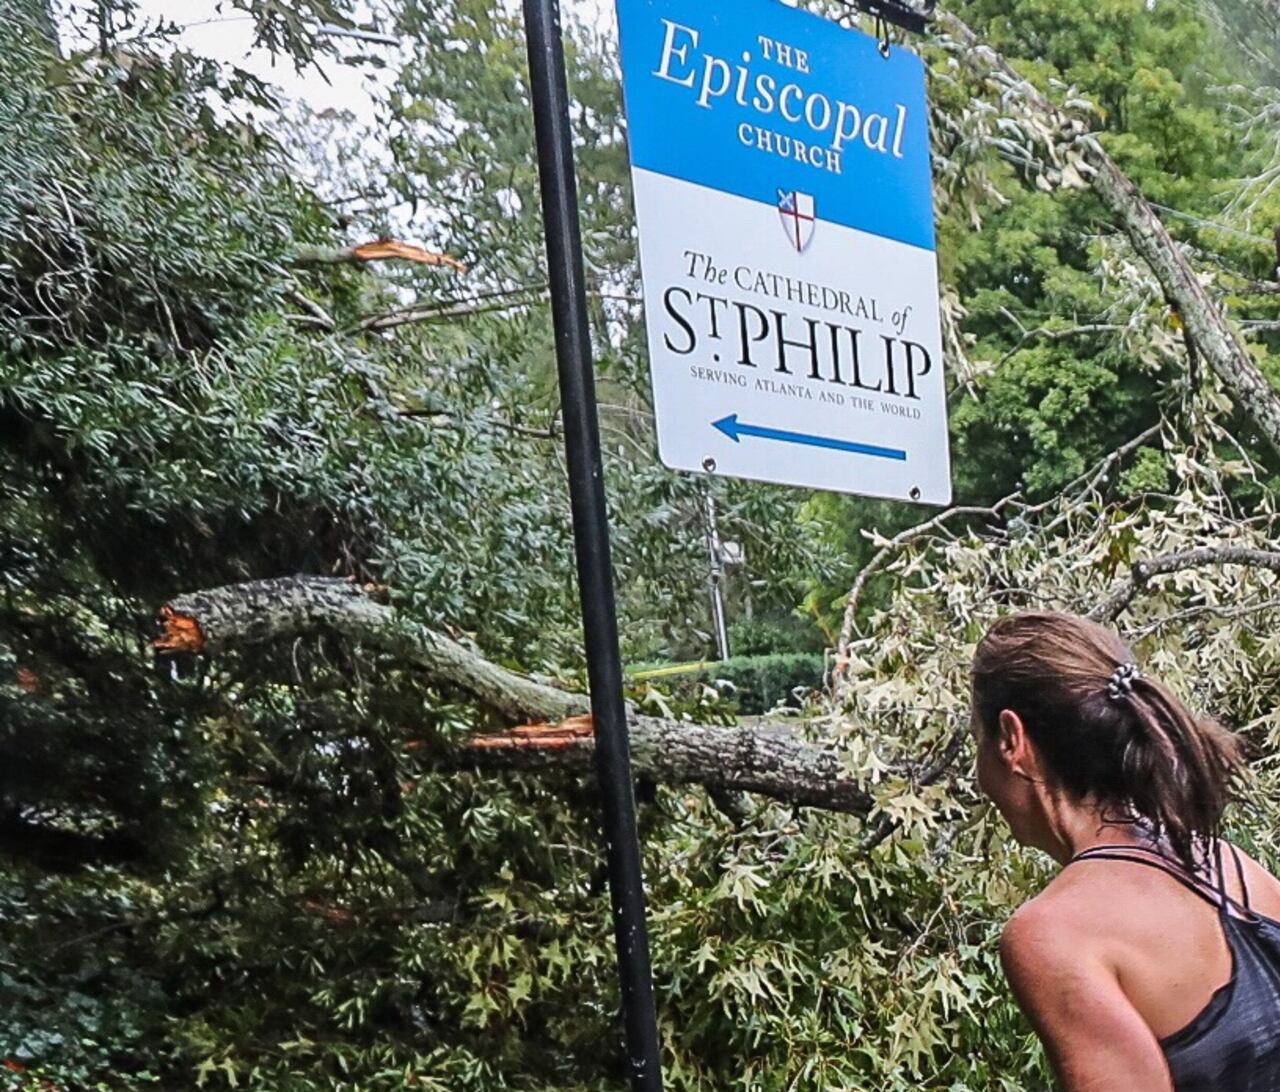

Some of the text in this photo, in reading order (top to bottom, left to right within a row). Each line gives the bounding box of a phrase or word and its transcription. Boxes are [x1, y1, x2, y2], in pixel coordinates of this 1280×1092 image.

[758, 35, 810, 73] THE
[652, 18, 906, 158] Episcopal
[738, 123, 842, 174] CHURCH
[684, 250, 912, 335] The CATHEDRAL of
[690, 365, 921, 420] SERVING ATLANTA AND THE WORLD
